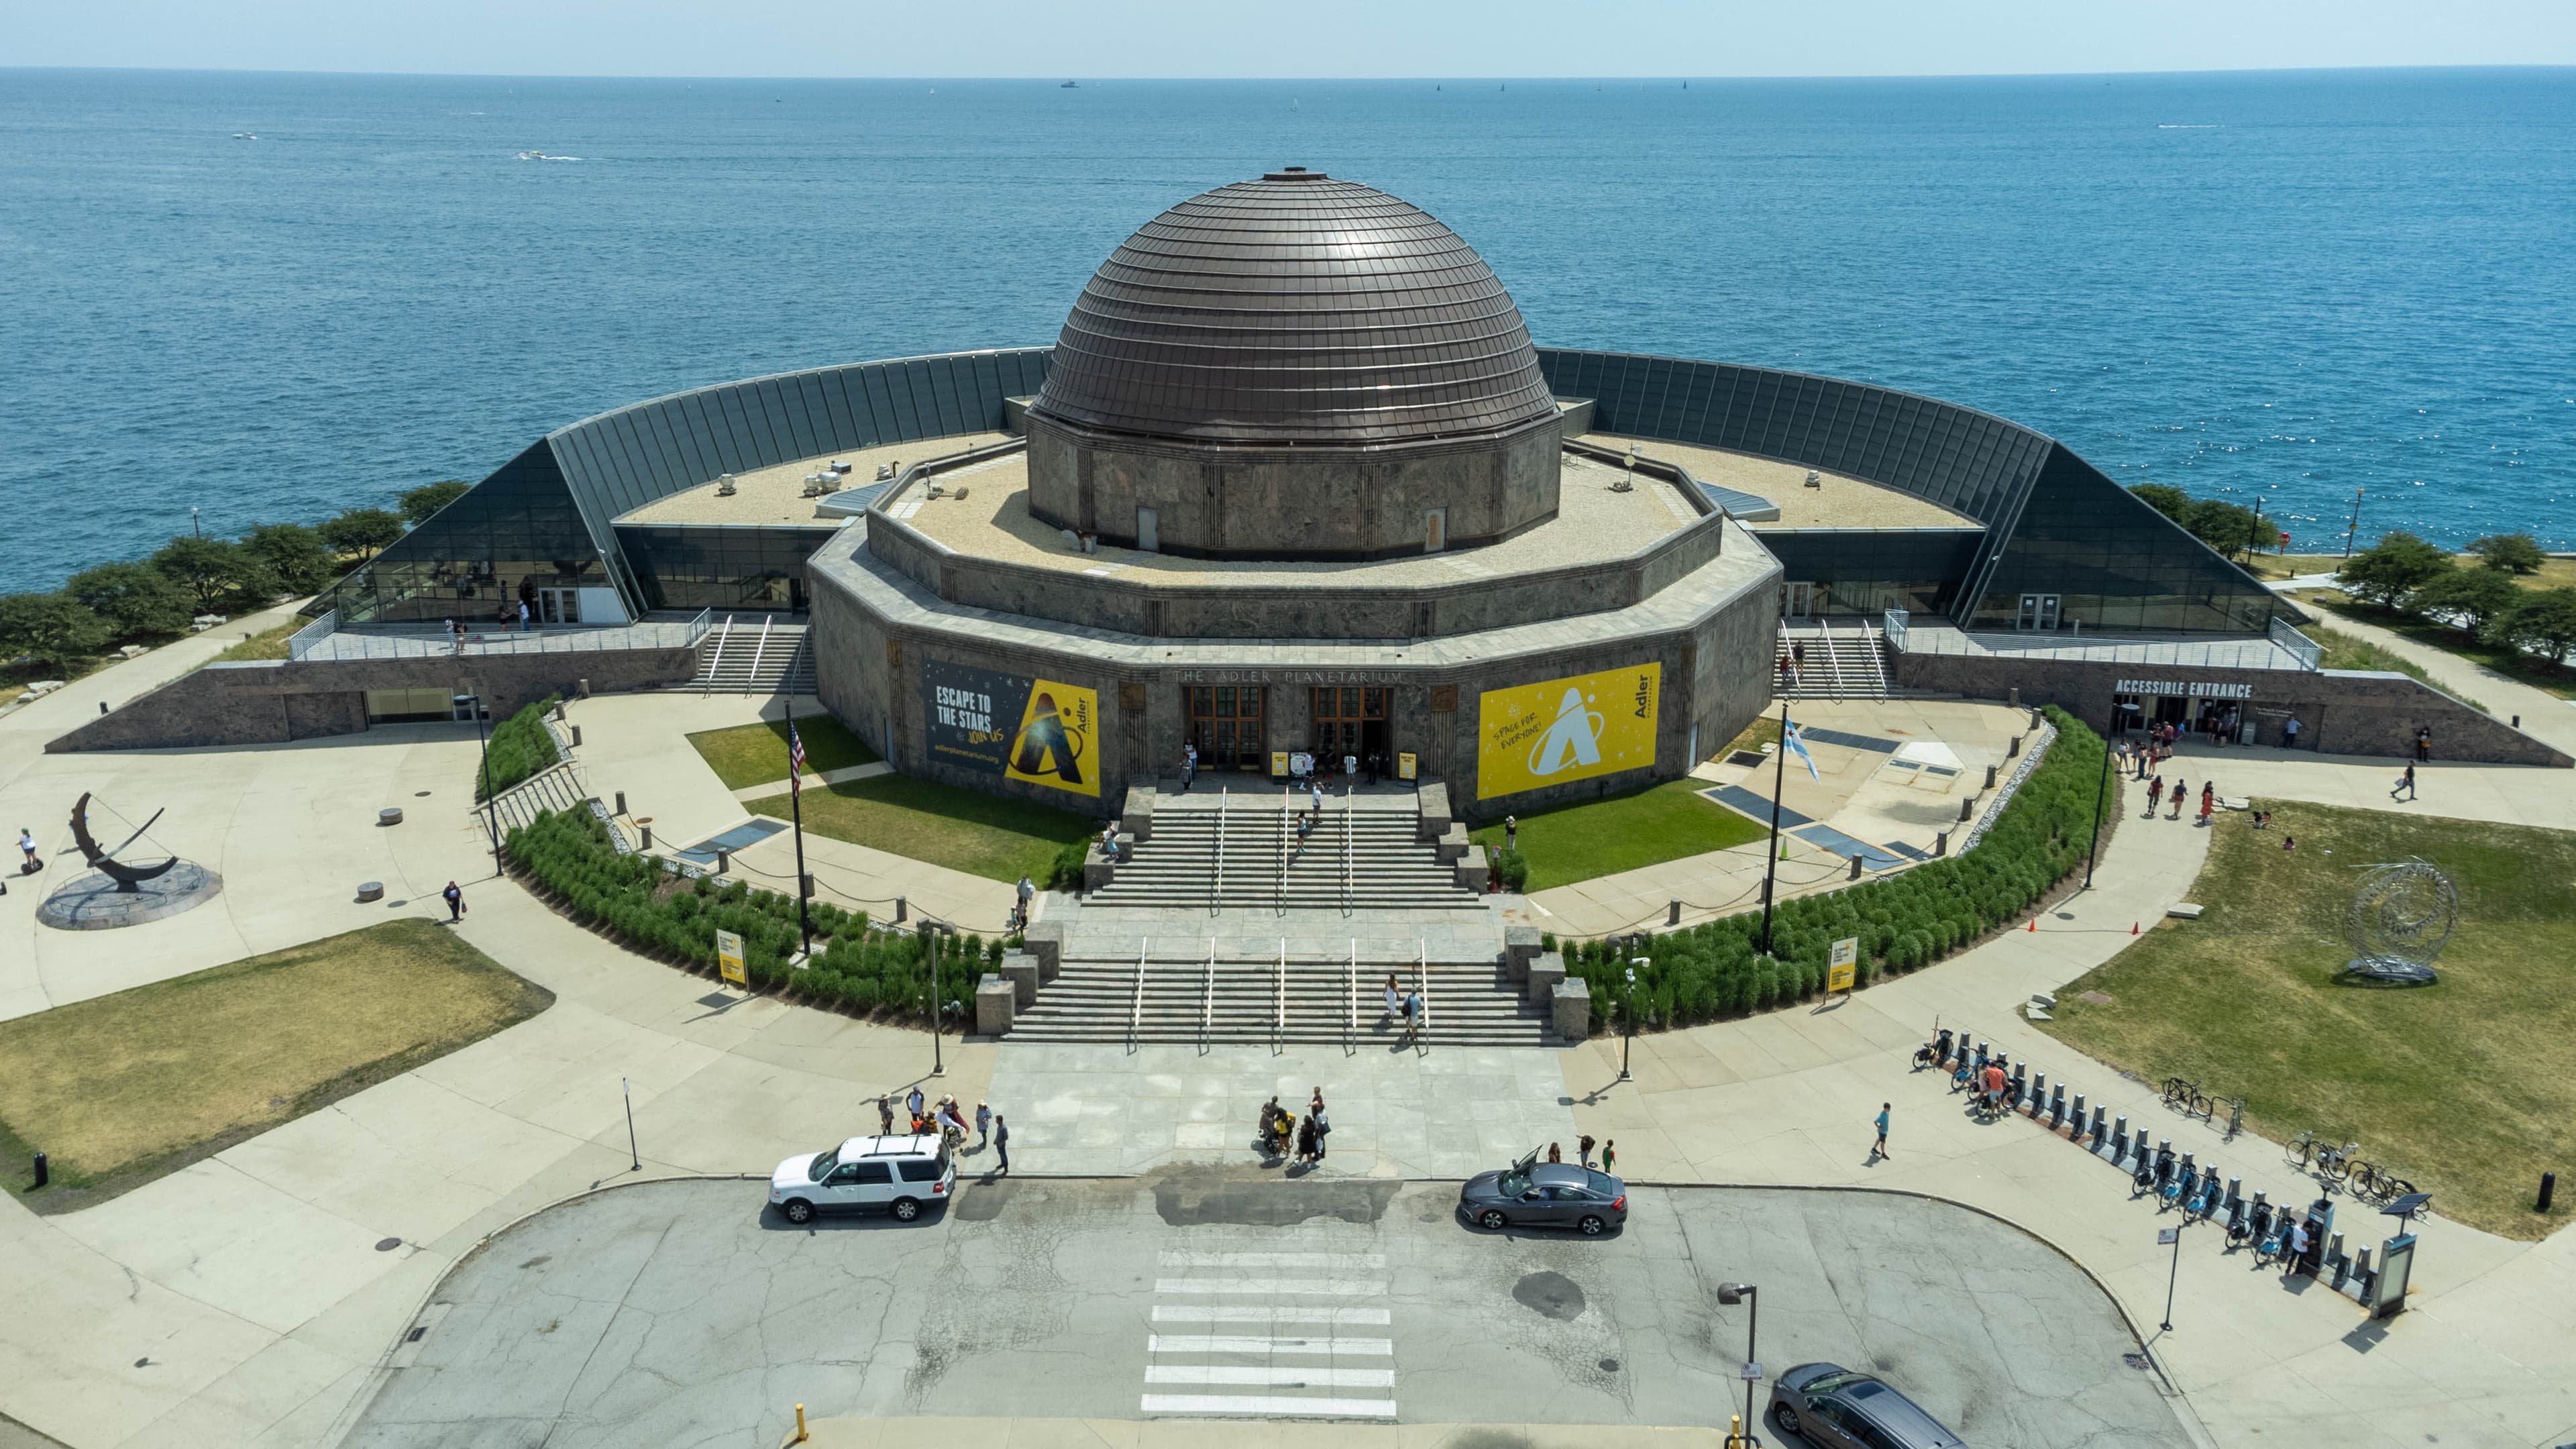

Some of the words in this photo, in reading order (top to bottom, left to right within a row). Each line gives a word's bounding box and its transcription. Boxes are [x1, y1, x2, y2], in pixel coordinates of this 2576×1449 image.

[1174, 671, 1204, 682] THE
[1217, 671, 1271, 682] ADLER
[1285, 671, 1404, 683] PLANETARIUM
[2115, 680, 2185, 696] ACCESSIBLE
[2188, 682, 2253, 698] ENTRANCE
[936, 685, 975, 710] ESCAPE
[977, 693, 991, 714] TO
[1635, 674, 1648, 719] Adler
[936, 705, 957, 727] THE
[958, 709, 992, 734] STARS
[1077, 697, 1087, 734] Adler
[1493, 722, 1519, 741] SPACE
[1521, 712, 1538, 727] FOR
[968, 730, 988, 745] JOIN
[989, 727, 1005, 743] US
